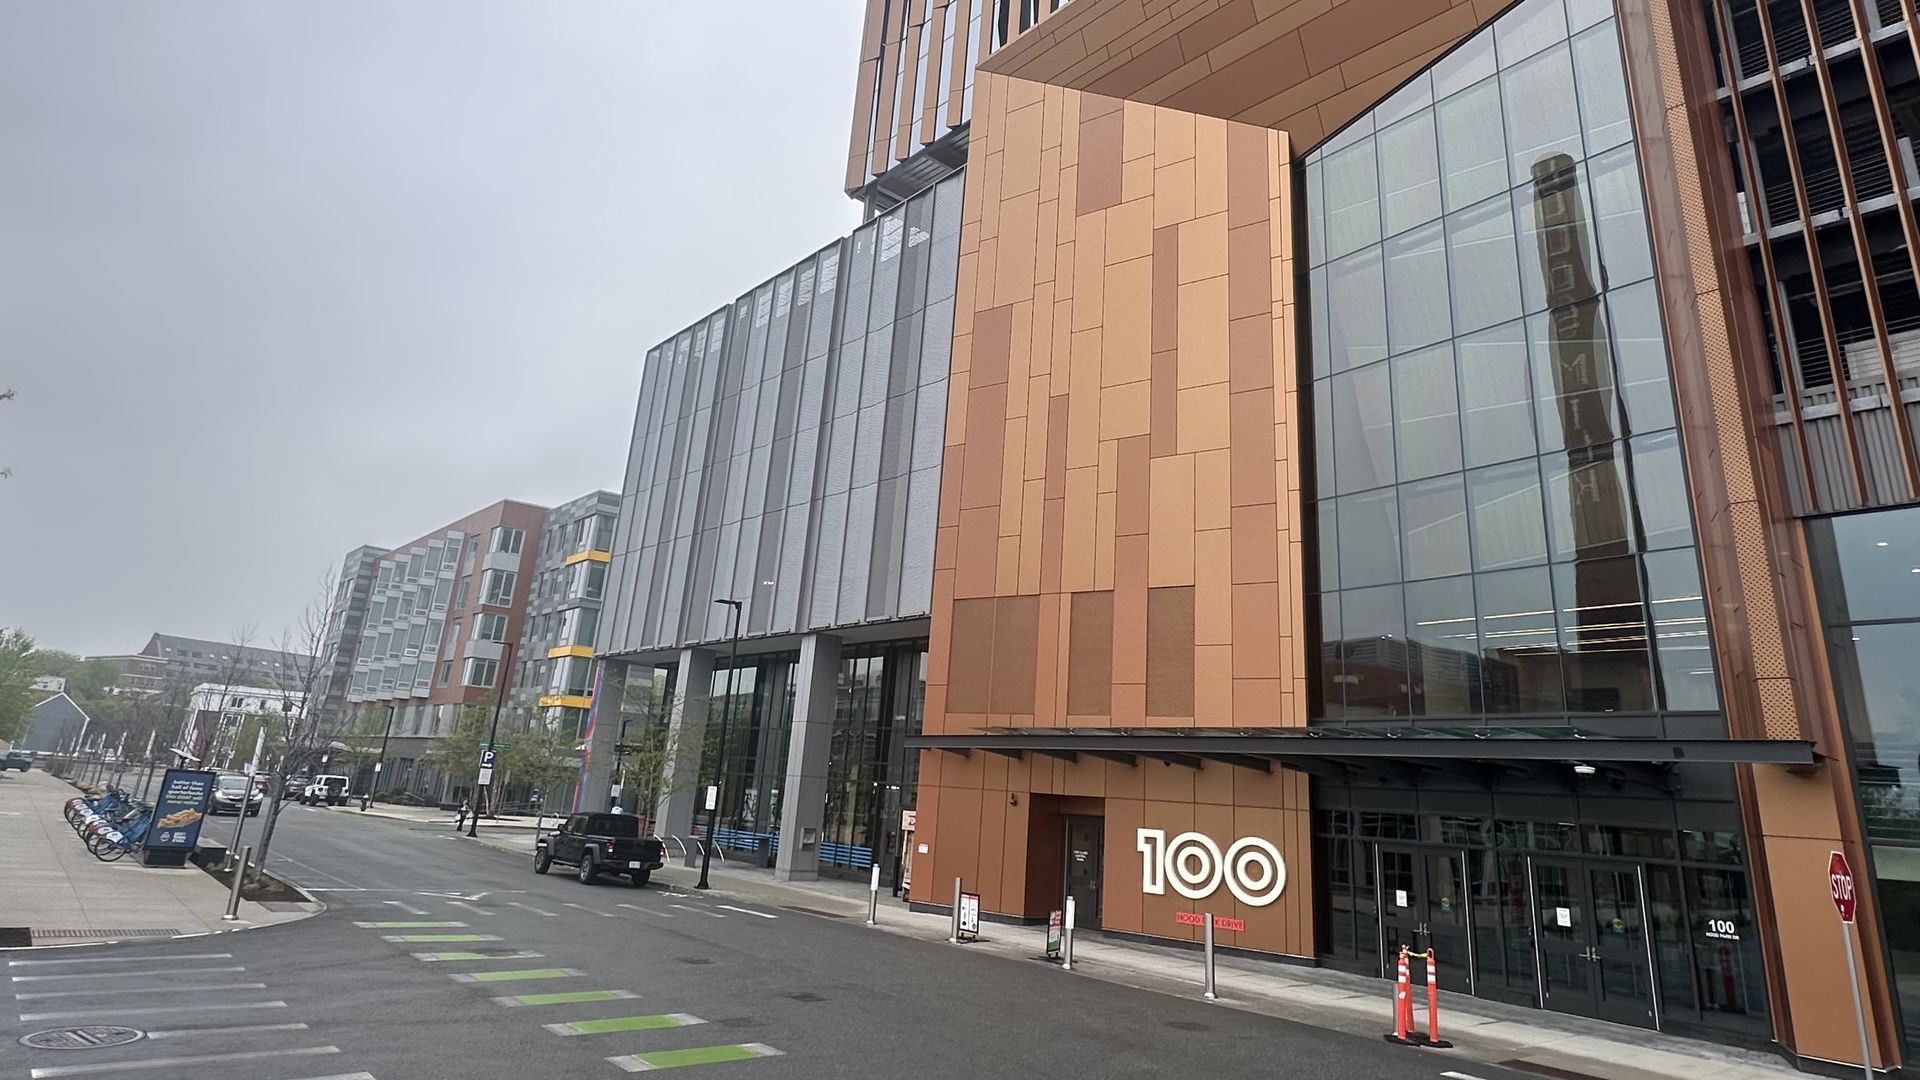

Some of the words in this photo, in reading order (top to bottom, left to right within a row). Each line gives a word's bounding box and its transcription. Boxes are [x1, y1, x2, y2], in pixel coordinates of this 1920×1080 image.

[484, 752, 494, 762] P
[1137, 828, 1286, 907] 100
[1831, 873, 1852, 900] STOP
[1177, 913, 1200, 923] HOOD
[1221, 919, 1243, 930] DRIVE
[1708, 919, 1735, 934] 100
